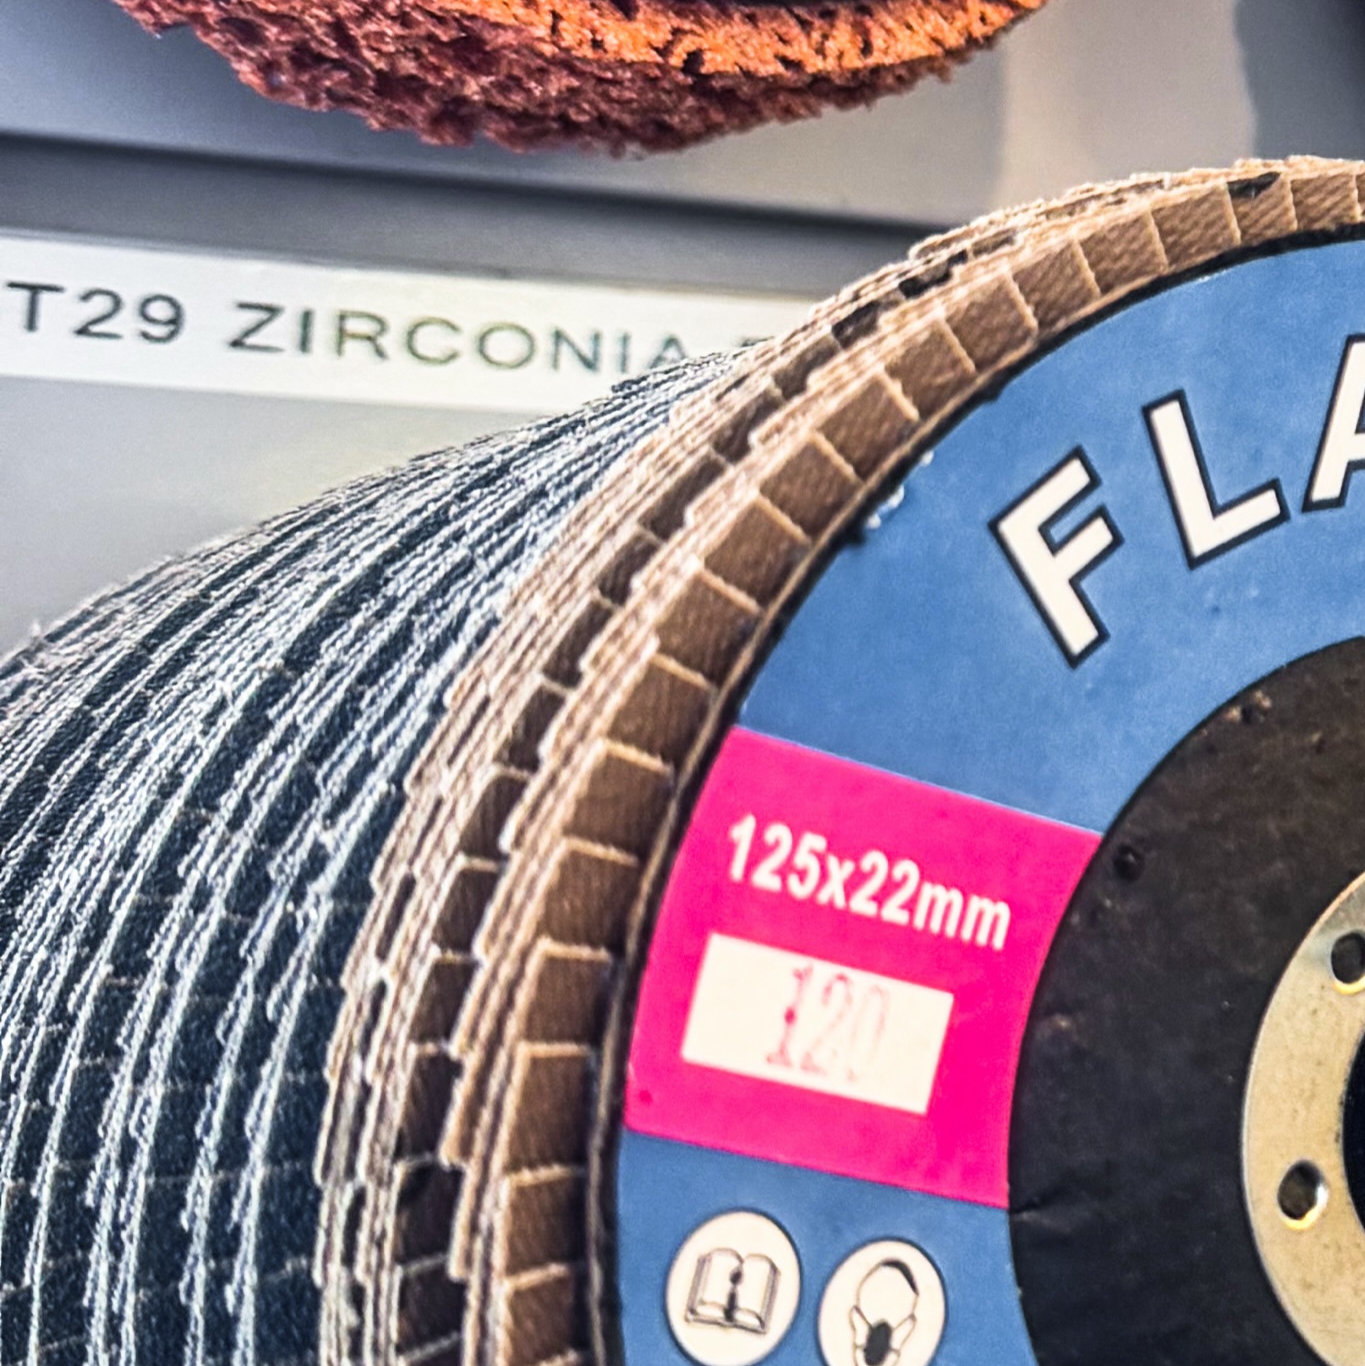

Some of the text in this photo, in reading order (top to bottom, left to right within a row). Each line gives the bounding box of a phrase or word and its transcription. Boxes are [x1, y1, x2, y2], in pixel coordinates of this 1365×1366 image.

[5, 280, 688, 373] T29 ZIRCONIA
[728, 813, 1012, 950] 125x22mm
